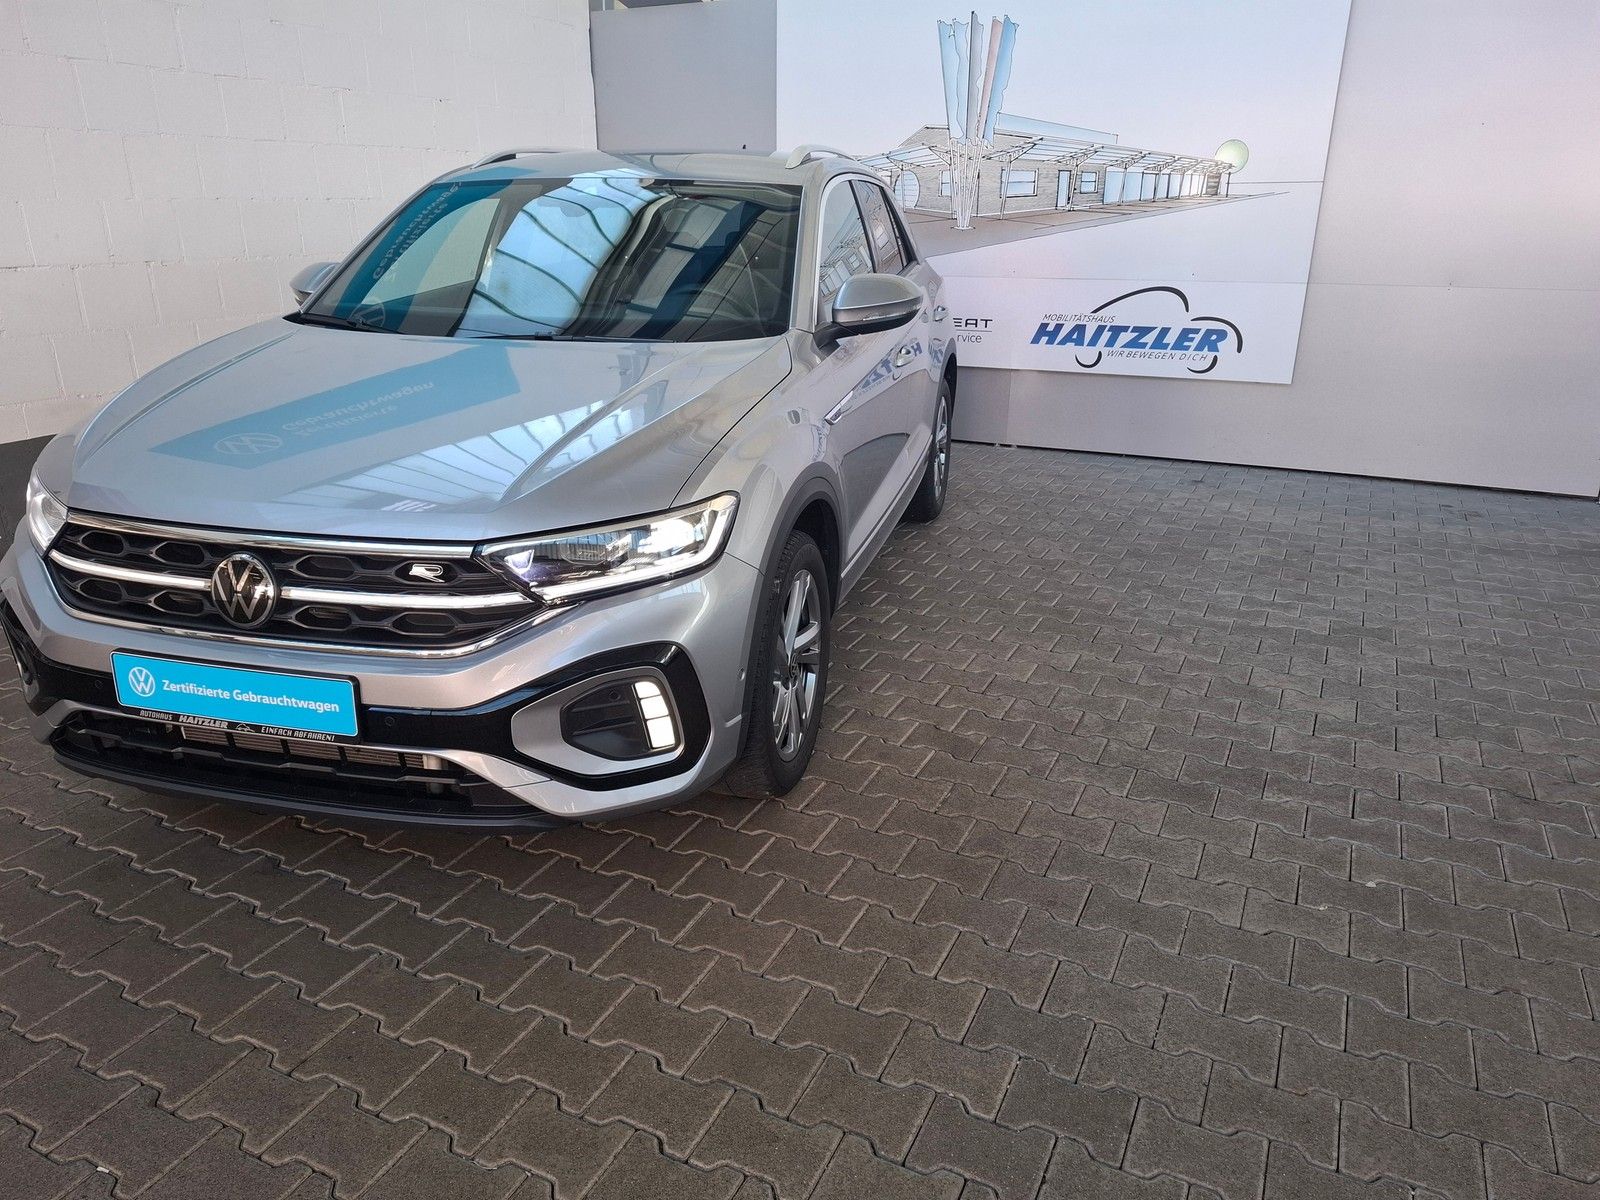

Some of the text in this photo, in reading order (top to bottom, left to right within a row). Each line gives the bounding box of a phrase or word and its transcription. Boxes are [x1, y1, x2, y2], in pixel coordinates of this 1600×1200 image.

[952, 317, 993, 329] EAT
[1042, 313, 1116, 323] MOBILITÄTSHAUS
[956, 332, 982, 344] rvice
[1029, 322, 1228, 353] HAITZLER
[1106, 350, 1208, 361] WIR BEWEGEN DICH
[162, 679, 340, 713] Zertifizierte Gebrauchtwagen
[139, 709, 335, 742] AUTOHAUS HAITZLER EINFACH ABFAHREN!
